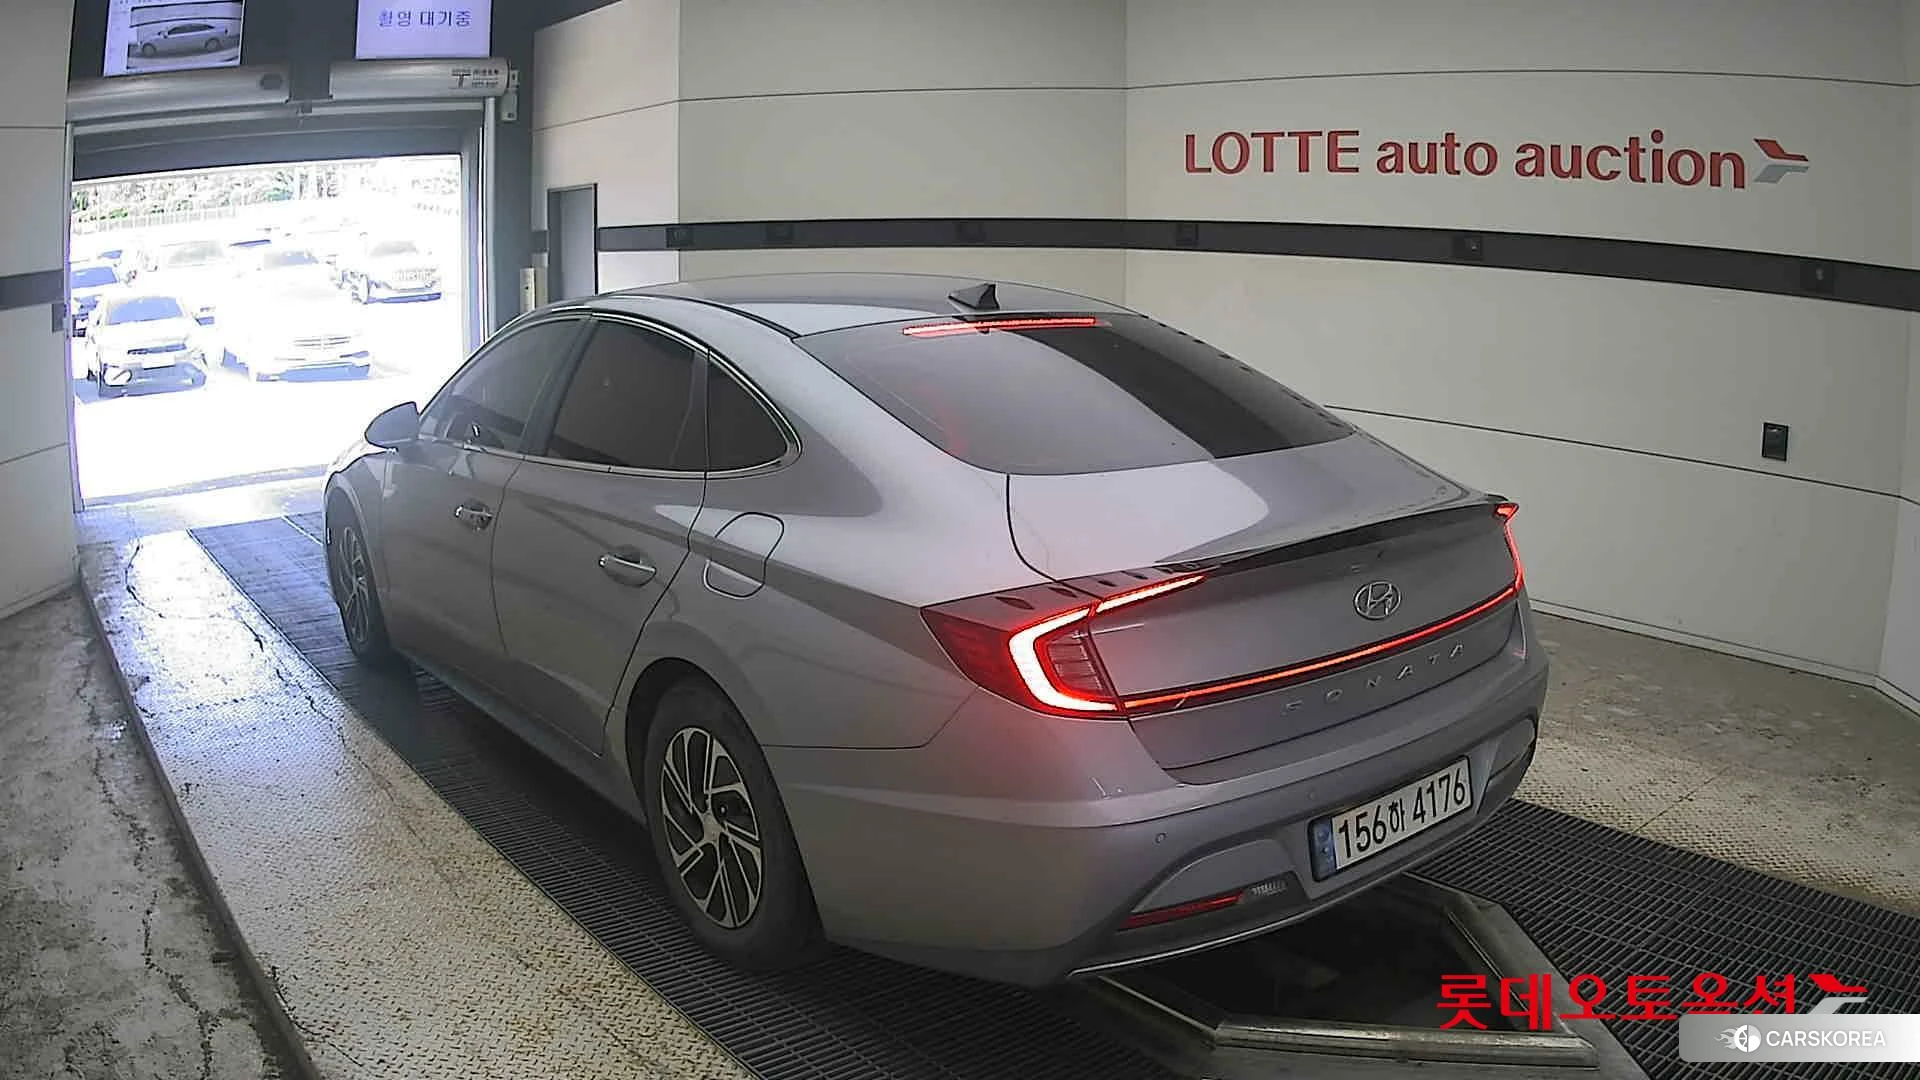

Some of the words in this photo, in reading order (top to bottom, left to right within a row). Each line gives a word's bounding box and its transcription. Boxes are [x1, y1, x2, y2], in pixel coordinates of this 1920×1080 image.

[419, 9, 472, 28] 대기중
[1185, 130, 1361, 175] LOTTE
[1376, 132, 1499, 176] auto
[1513, 129, 1746, 189] auction
[1338, 797, 1406, 858] 156하
[1412, 767, 1466, 824] 4176
